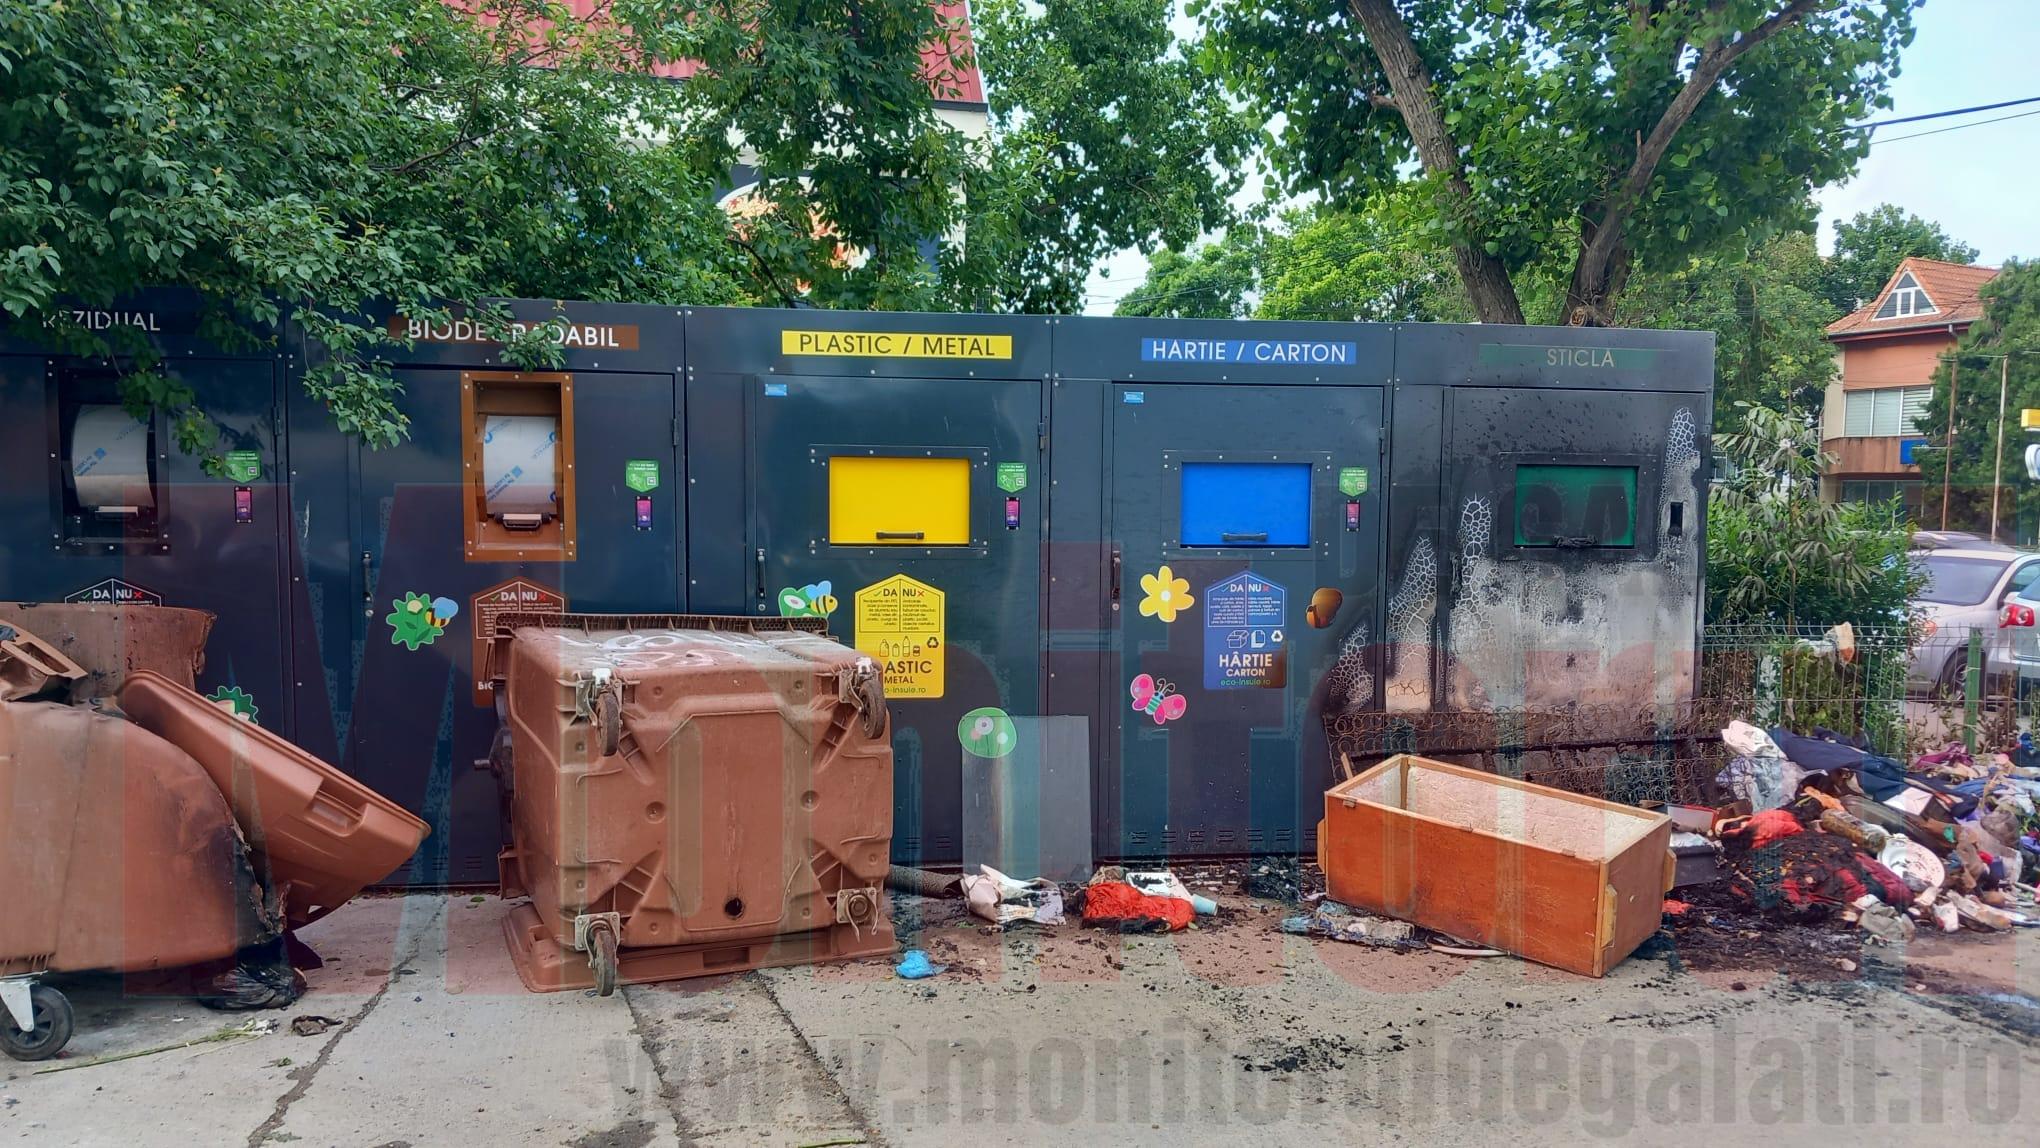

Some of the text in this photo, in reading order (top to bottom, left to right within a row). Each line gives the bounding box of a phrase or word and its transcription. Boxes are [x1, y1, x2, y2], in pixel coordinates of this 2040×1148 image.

[42, 310, 161, 332] ZIDUAL
[799, 333, 996, 357] PLASTIC / METAL
[1152, 339, 1346, 363] HARTIE / CARTON
[1546, 348, 1615, 368] STICLA
[92, 588, 132, 600] DA NU
[882, 588, 917, 597] DA NU
[1230, 583, 1262, 593] DA NU
[500, 591, 538, 601] DA NU
[1219, 651, 1273, 668] HÂRTIE
[884, 660, 933, 674] ASTIC
[1226, 668, 1266, 677] CARTON
[884, 675, 914, 684] METAL
